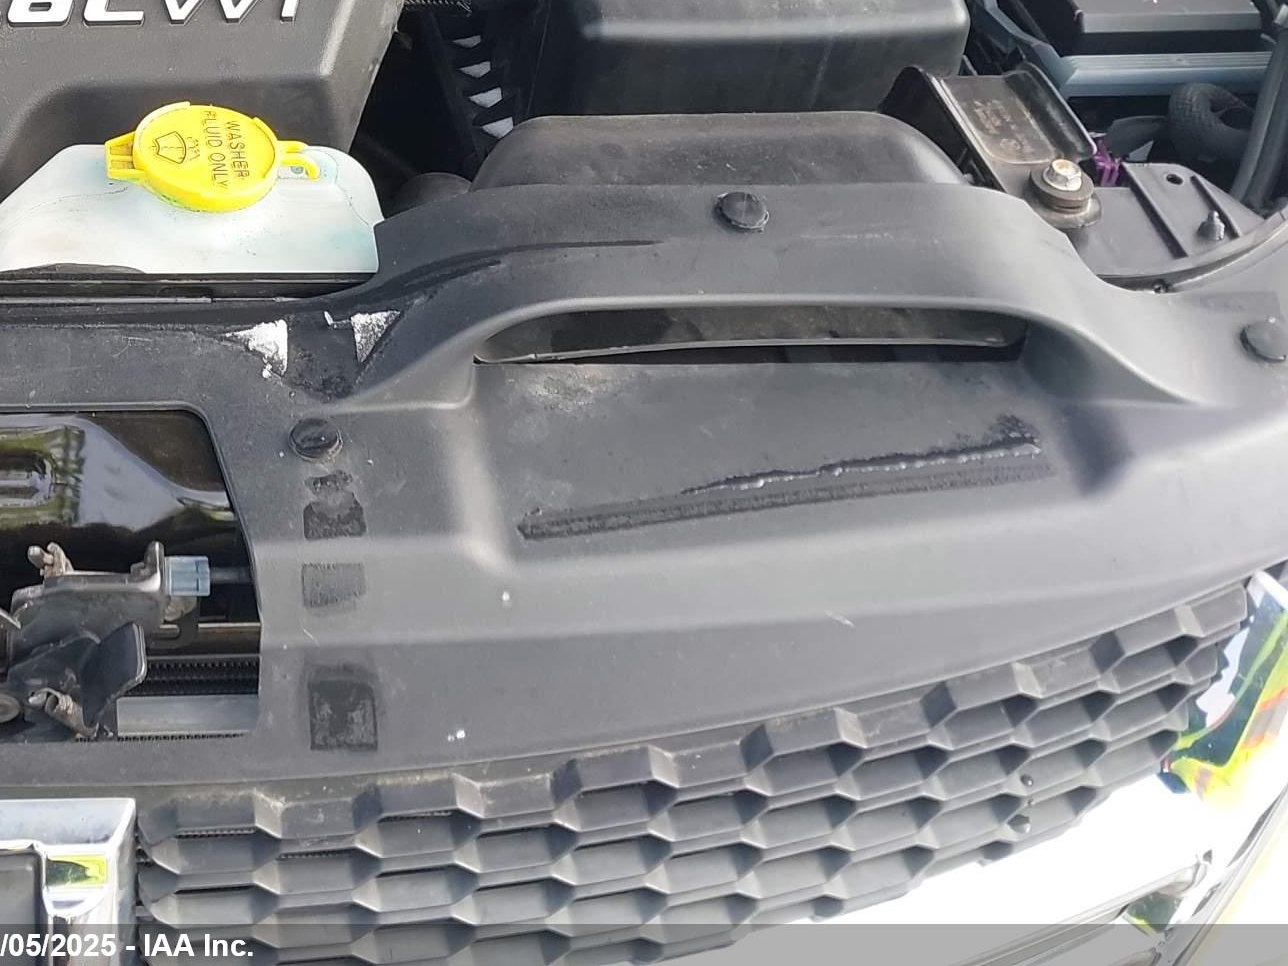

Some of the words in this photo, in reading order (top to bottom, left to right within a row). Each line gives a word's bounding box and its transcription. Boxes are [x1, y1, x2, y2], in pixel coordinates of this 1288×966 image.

[202, 110, 223, 148] FLUID
[225, 120, 250, 179] WASHER
[209, 152, 229, 188] ONLY
